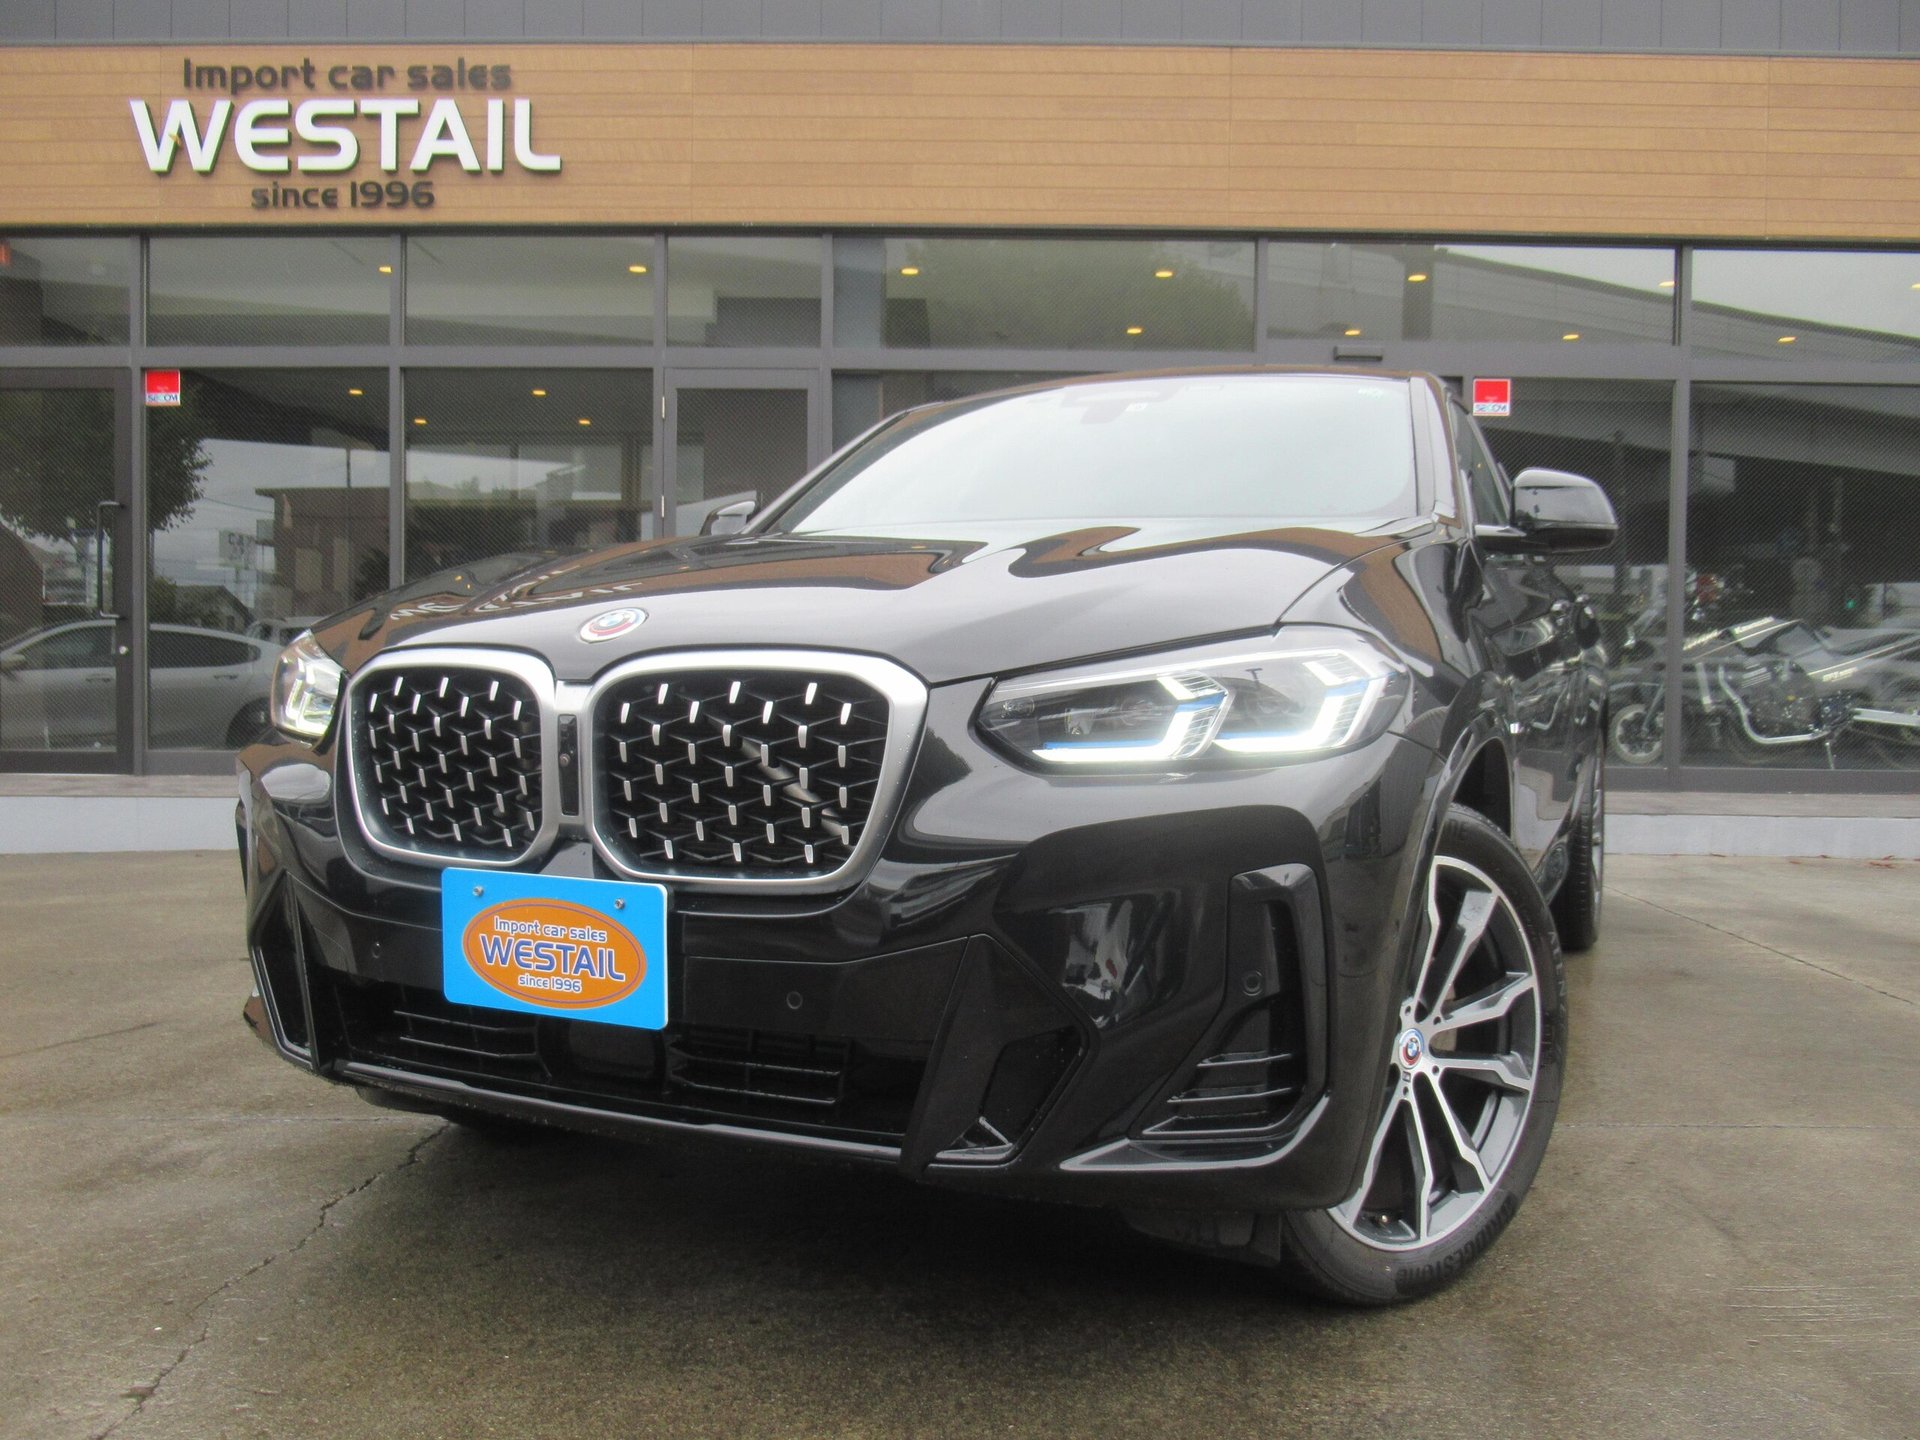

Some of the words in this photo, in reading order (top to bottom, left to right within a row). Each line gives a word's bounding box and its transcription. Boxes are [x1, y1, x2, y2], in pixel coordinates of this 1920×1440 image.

[183, 57, 316, 96] Import
[328, 64, 395, 90] car
[406, 56, 512, 90] sales
[130, 98, 562, 174] WESTAIL
[250, 181, 339, 209] since
[350, 181, 436, 209] 1996
[494, 916, 540, 935] Import
[543, 924, 567, 938] car
[570, 926, 607, 942] sales
[480, 933, 626, 981] WESTAIL
[518, 973, 549, 988] since
[551, 977, 582, 993] 1996
